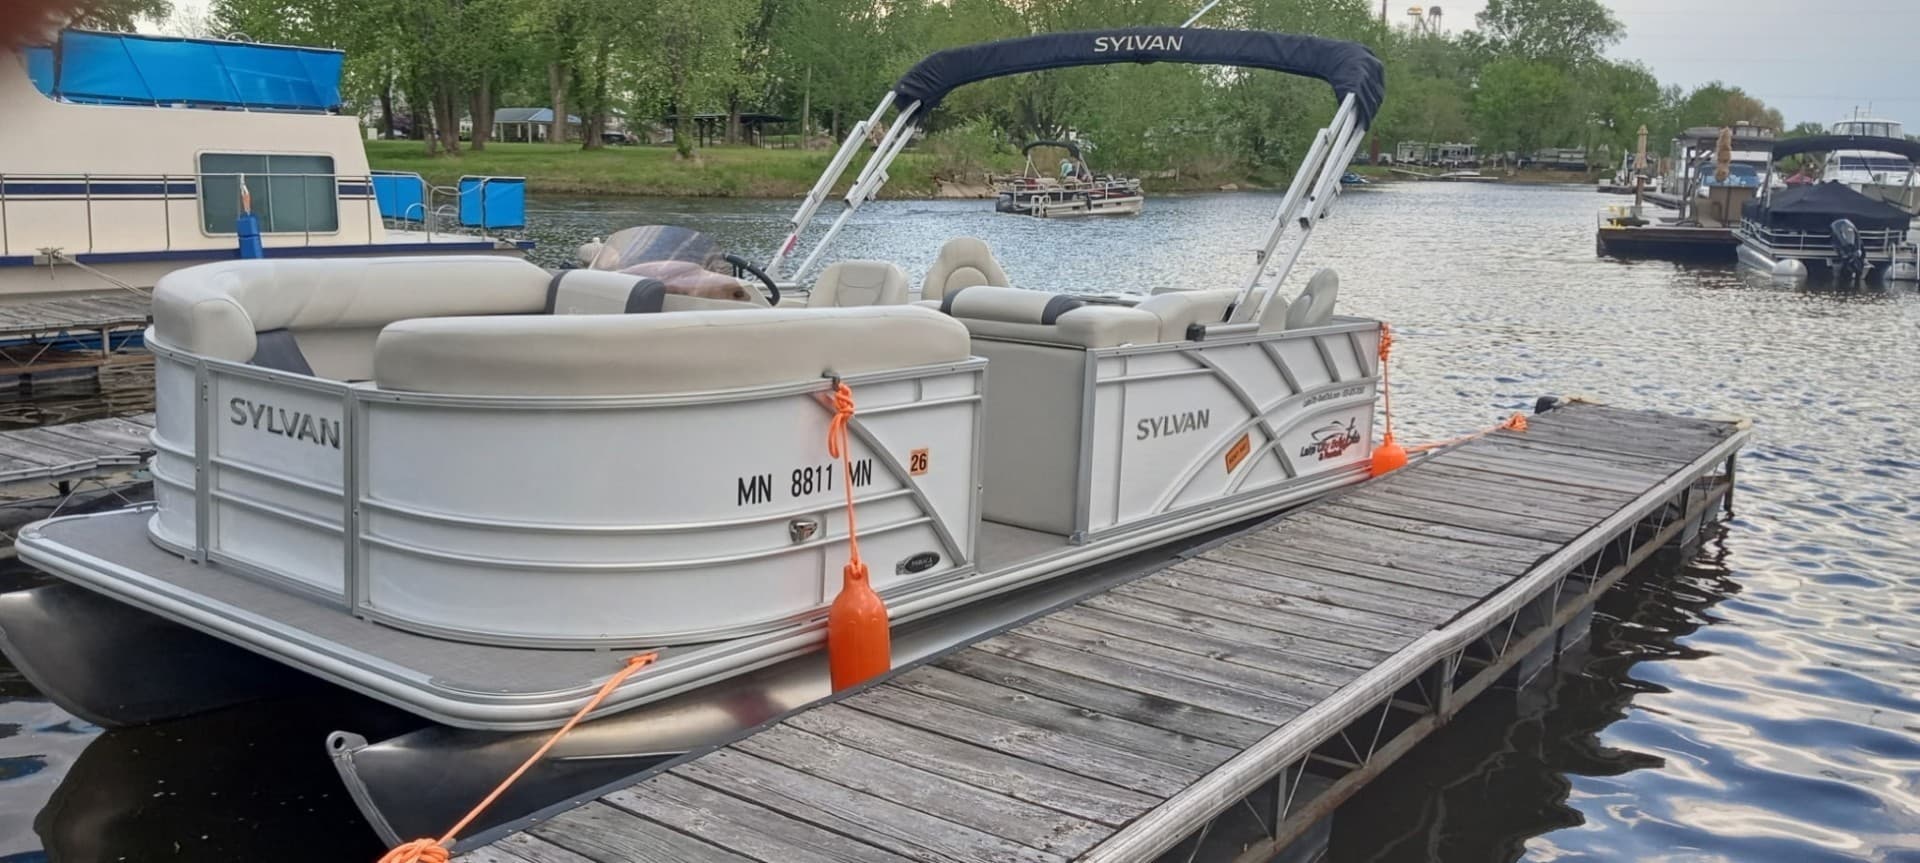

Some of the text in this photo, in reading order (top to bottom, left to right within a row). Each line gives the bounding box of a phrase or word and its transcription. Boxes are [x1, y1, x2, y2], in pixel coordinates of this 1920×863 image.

[1093, 35, 1184, 52] SYLVAN
[230, 397, 340, 450] SYLVAN
[1136, 408, 1210, 441] SYLVAN
[911, 453, 927, 472] 26
[737, 473, 772, 506] MN
[791, 463, 833, 497] 8811
